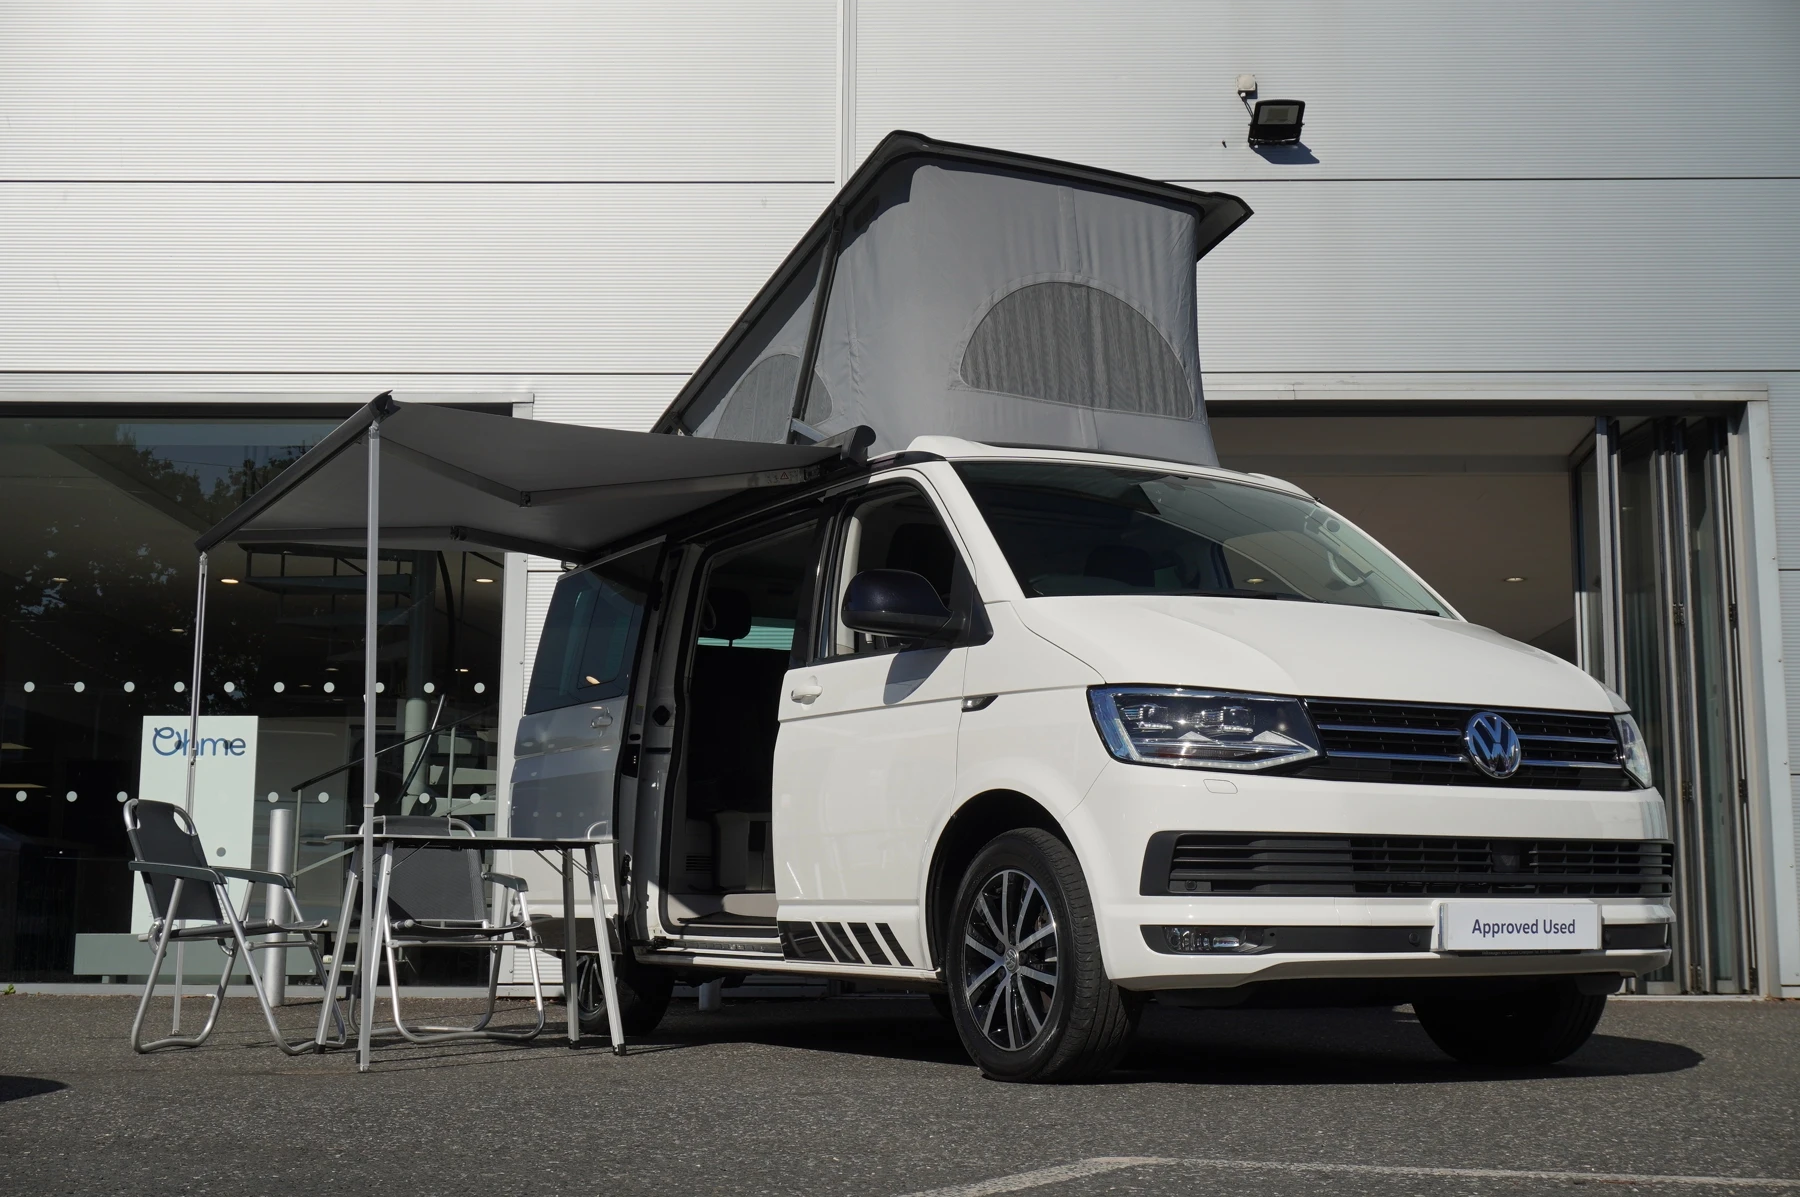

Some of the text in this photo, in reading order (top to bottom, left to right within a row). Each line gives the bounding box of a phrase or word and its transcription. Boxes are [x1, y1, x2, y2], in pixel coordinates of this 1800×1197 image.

[152, 726, 246, 756] Ohme
[1471, 918, 1576, 938] Approved Used
